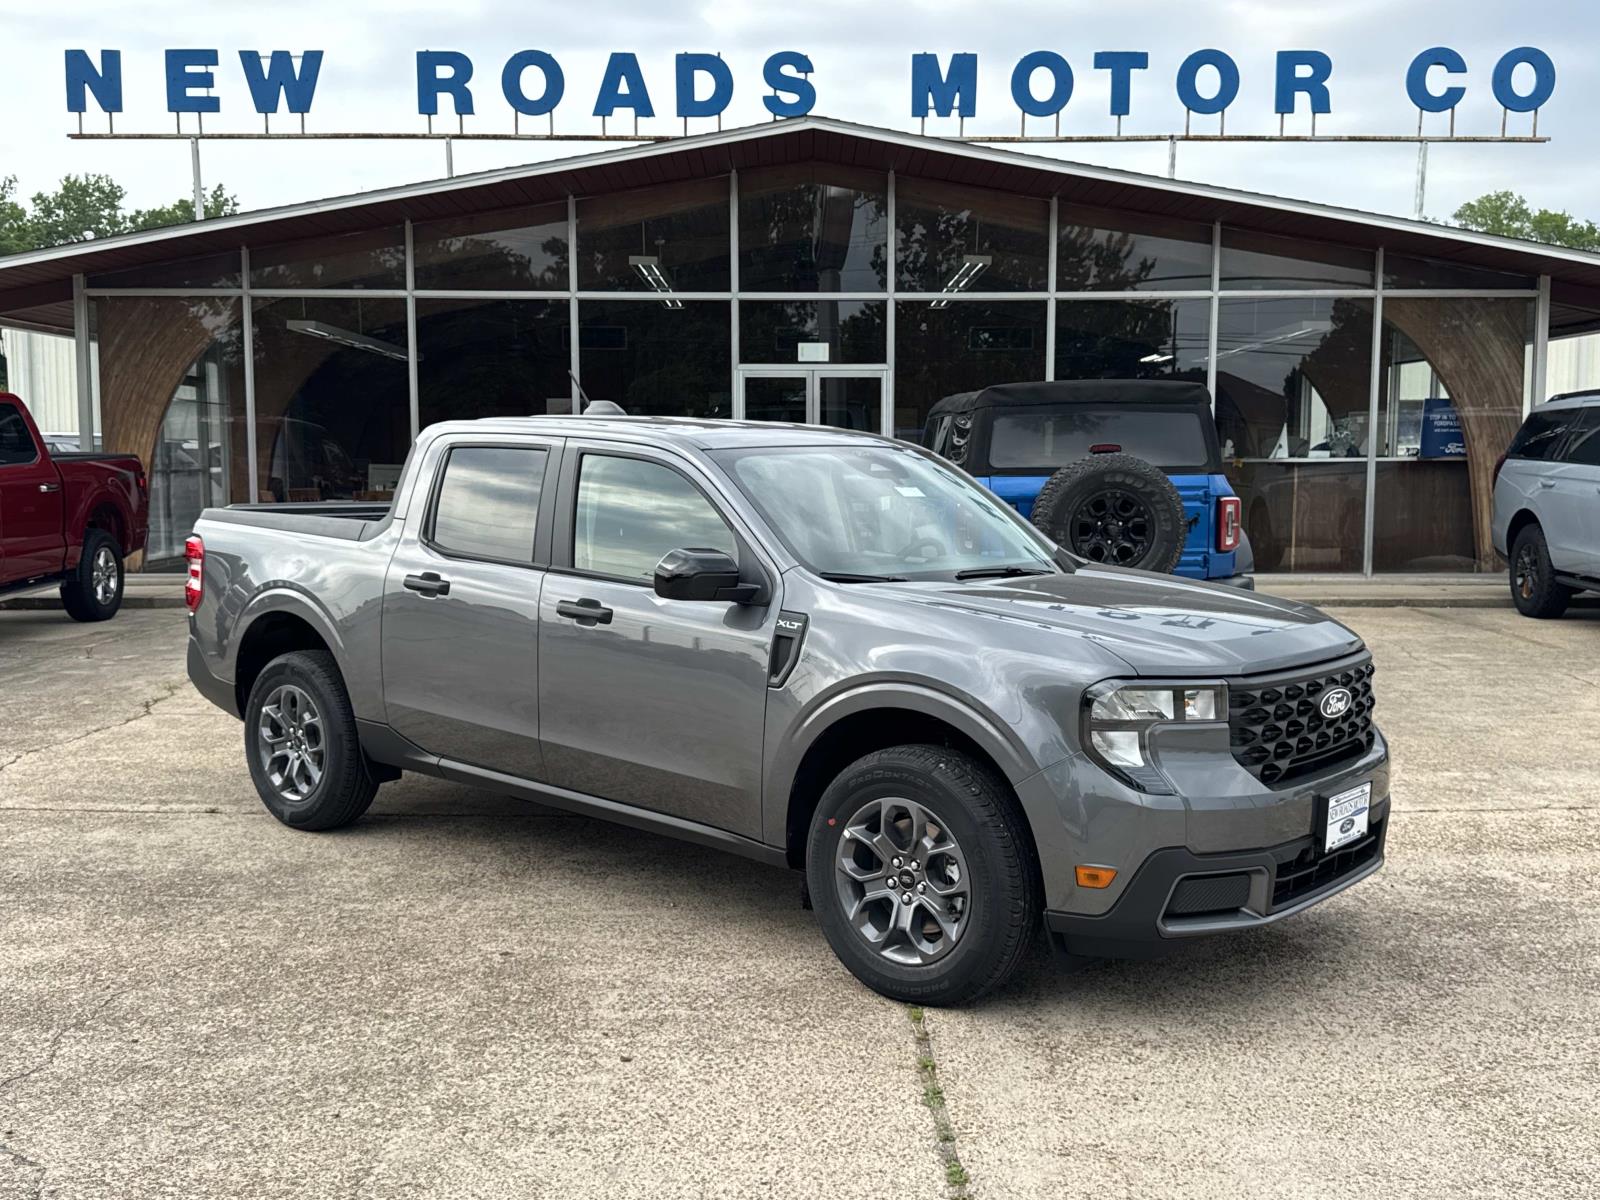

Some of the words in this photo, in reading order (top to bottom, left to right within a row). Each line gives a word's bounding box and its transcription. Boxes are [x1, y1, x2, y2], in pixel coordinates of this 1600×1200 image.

[65, 49, 324, 115] NEW
[417, 49, 816, 118] ROADS
[911, 49, 1333, 118] MOTOR
[1406, 46, 1556, 114] CO
[776, 619, 803, 629] XLT
[1326, 692, 1347, 715] Ford
